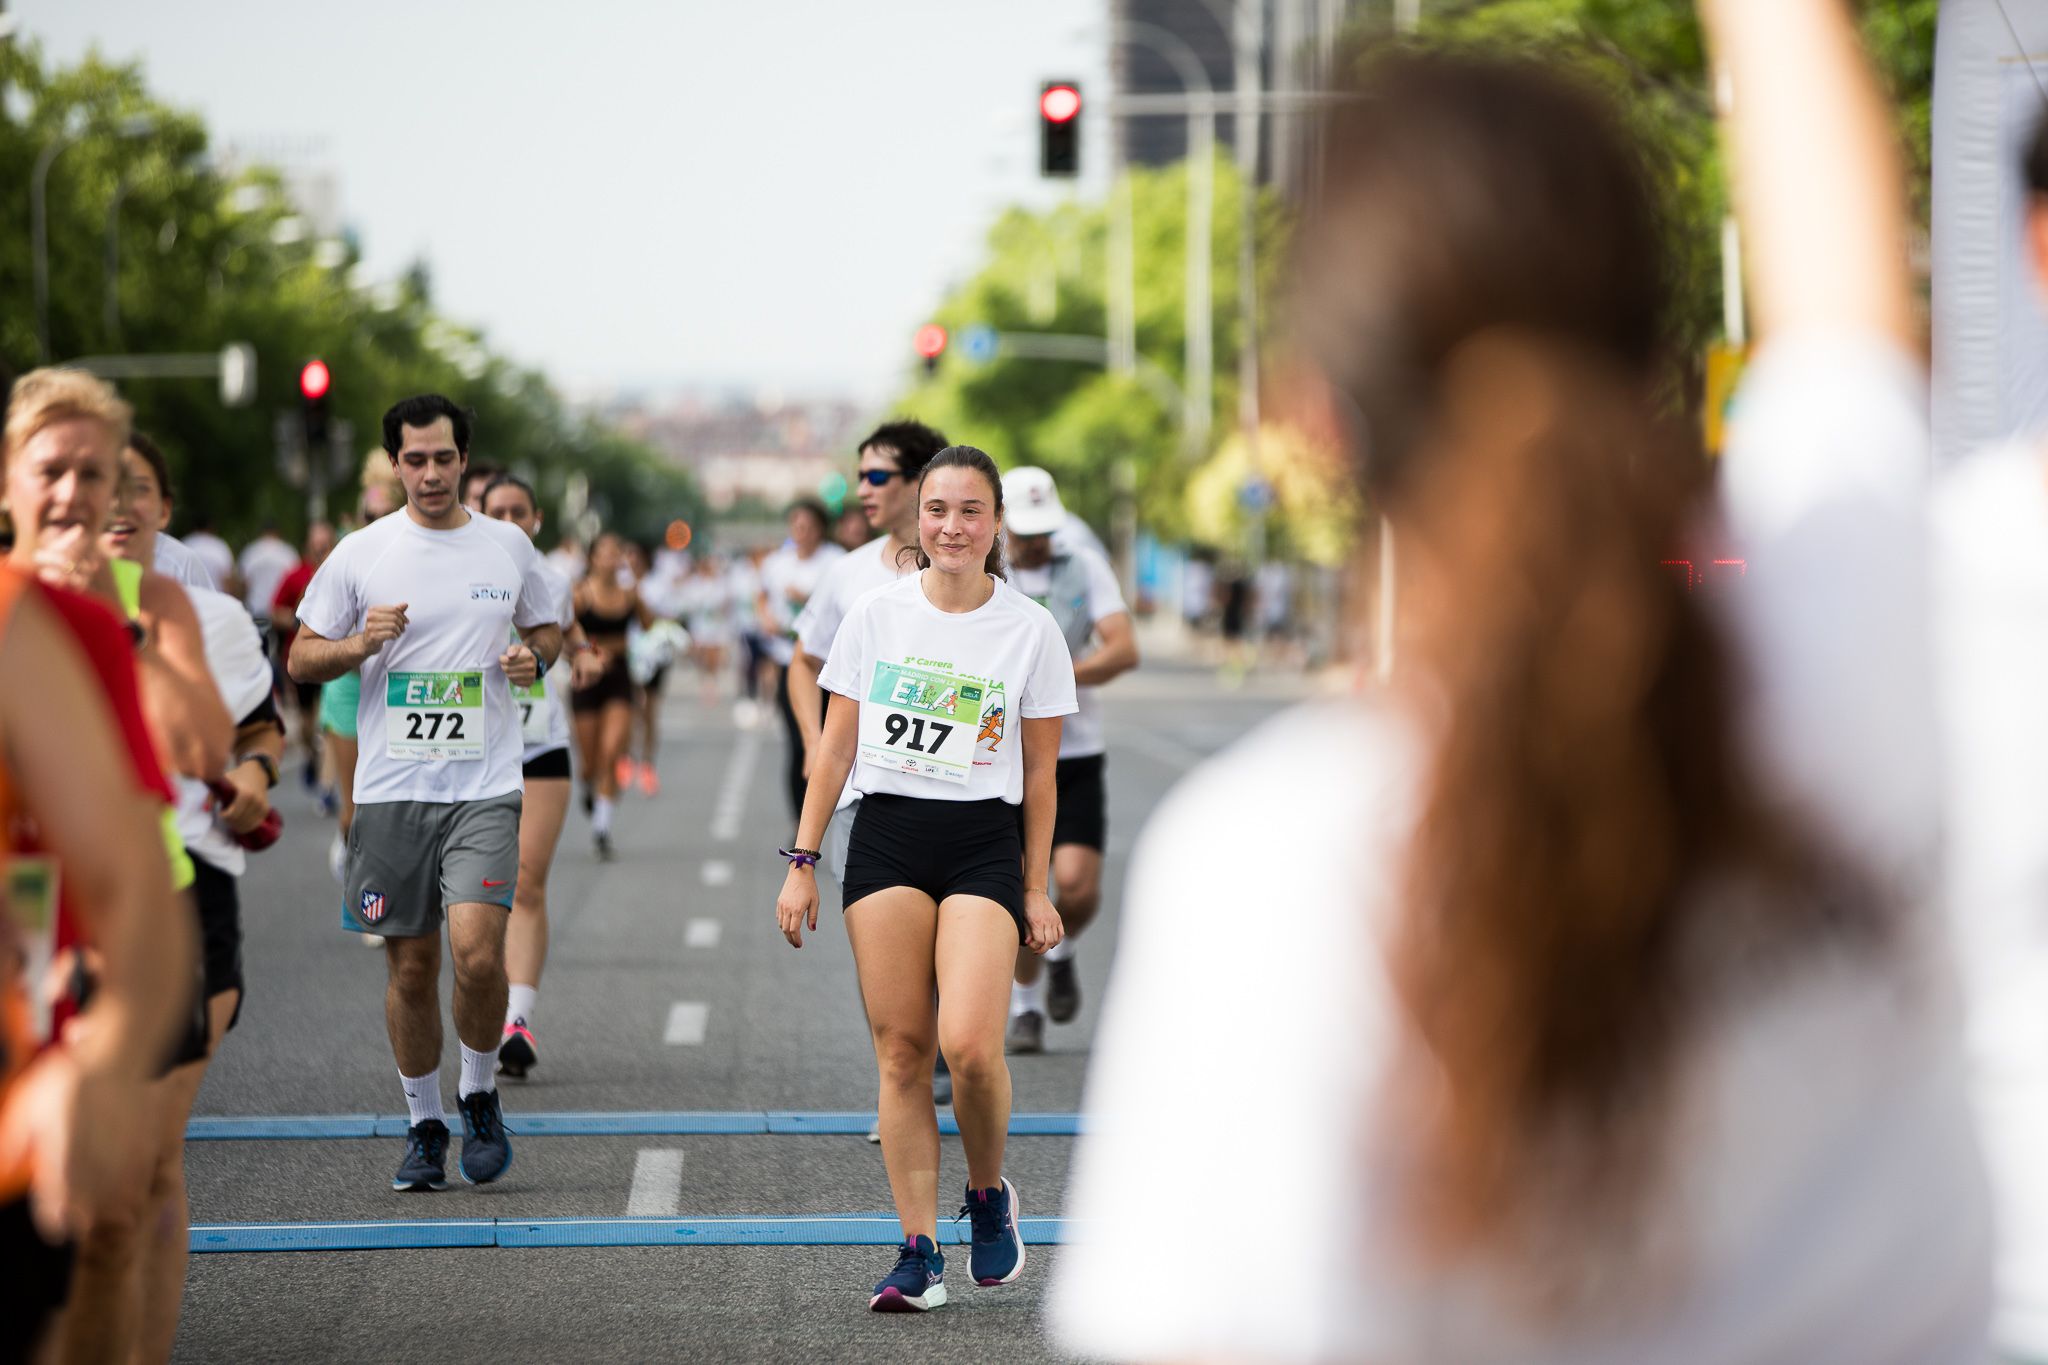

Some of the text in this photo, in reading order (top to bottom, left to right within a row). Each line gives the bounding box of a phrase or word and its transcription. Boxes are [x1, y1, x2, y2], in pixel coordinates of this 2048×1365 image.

[916, 657, 953, 669] Carrera
[901, 669, 929, 681] MADRID
[930, 674, 946, 684] CON
[988, 679, 1005, 690] LA
[405, 680, 463, 705] ELA
[889, 676, 957, 716] ELA
[406, 712, 465, 740] 272
[885, 713, 954, 755] 917
